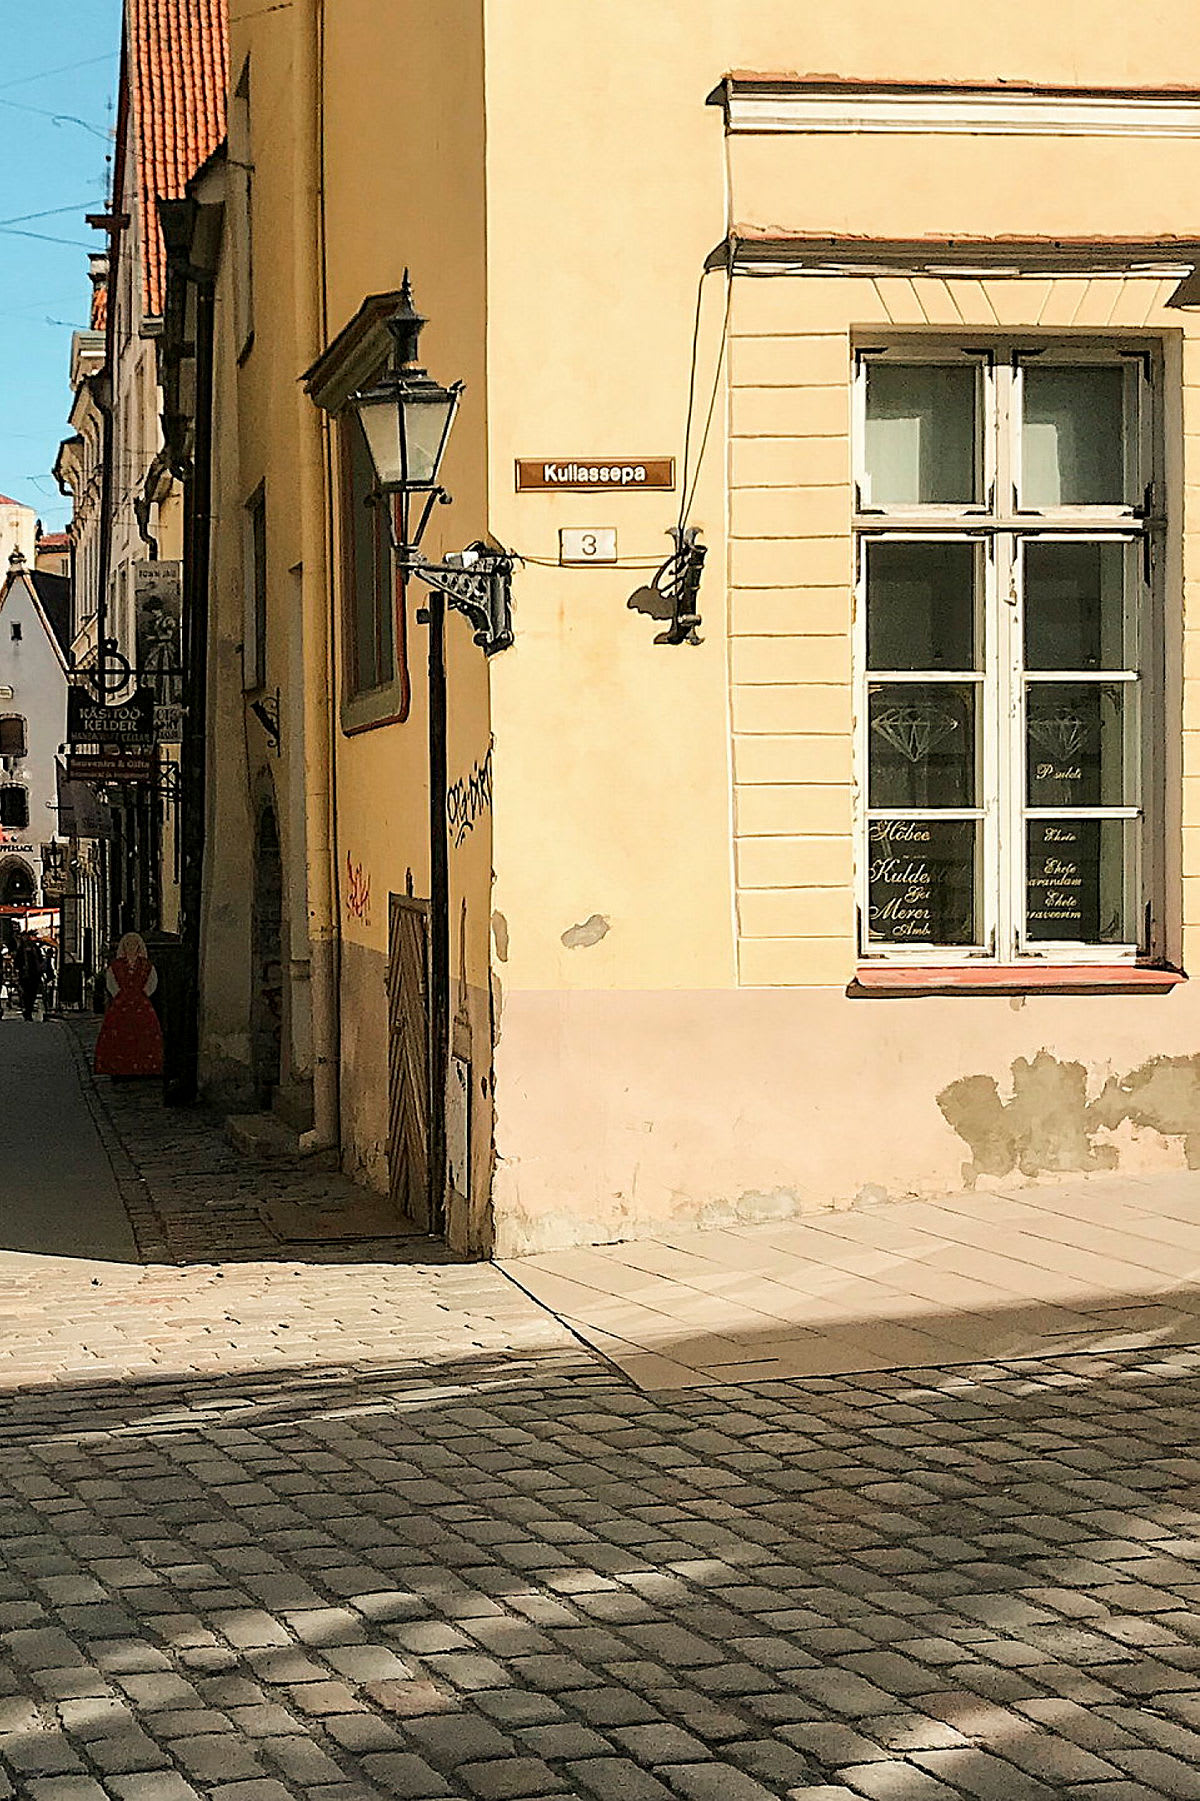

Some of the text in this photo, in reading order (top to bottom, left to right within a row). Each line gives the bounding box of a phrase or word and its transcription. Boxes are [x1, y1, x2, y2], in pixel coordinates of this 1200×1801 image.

[543, 463, 647, 485] Kullassepa
[581, 534, 597, 556] 3
[83, 719, 139, 732] KELDER
